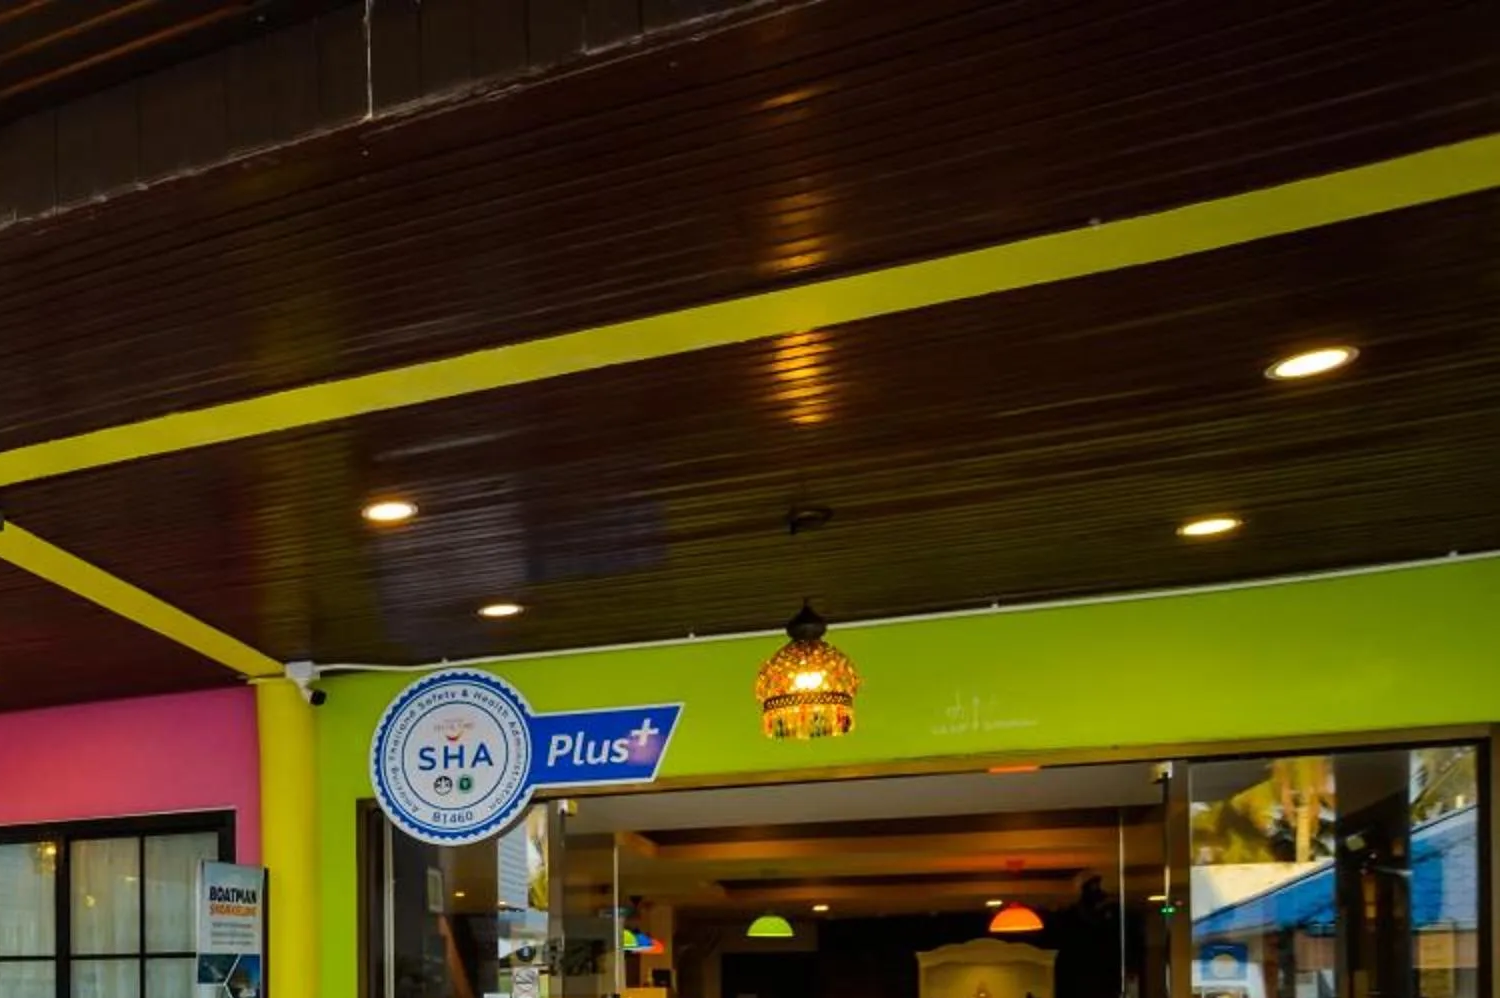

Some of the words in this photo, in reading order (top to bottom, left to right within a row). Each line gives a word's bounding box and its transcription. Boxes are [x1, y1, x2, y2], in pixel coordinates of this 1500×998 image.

[417, 689, 457, 711] Safety
[461, 688, 469, 698] &
[473, 690, 509, 721] Health
[418, 742, 494, 771] SHA
[209, 885, 257, 905] BOATMAN
